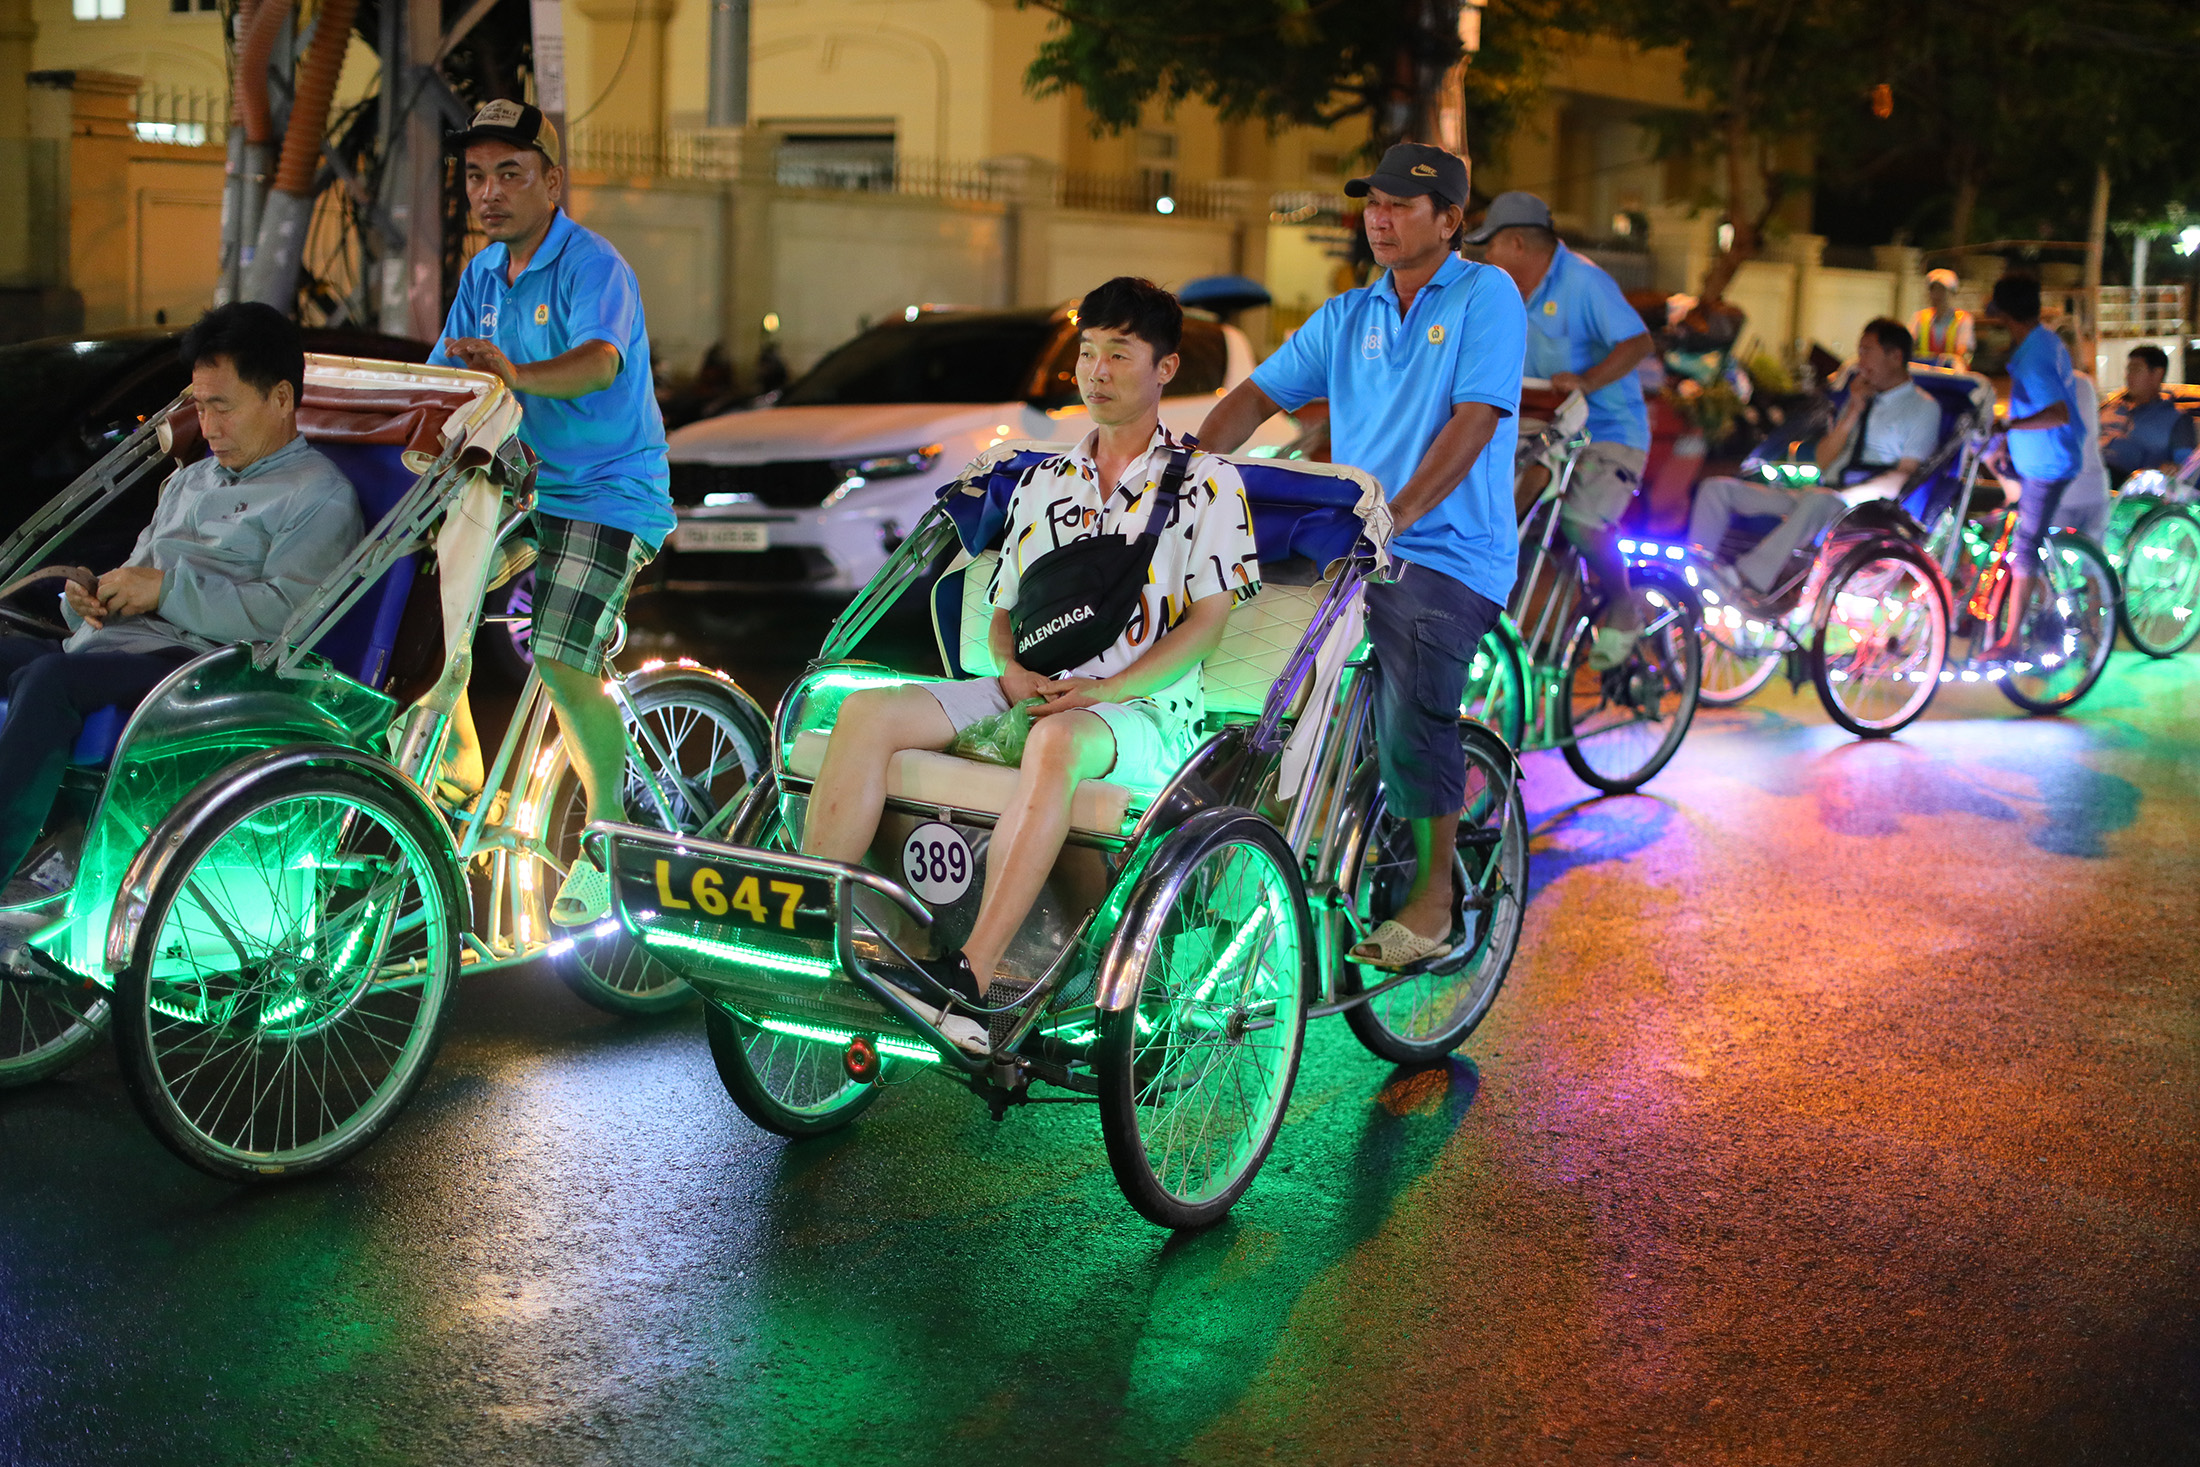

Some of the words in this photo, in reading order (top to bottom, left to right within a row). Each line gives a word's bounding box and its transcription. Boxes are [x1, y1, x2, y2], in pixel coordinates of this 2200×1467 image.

[1018, 604, 1095, 654] BALENCIAGA
[909, 840, 967, 884] 389
[655, 859, 805, 930] L647
